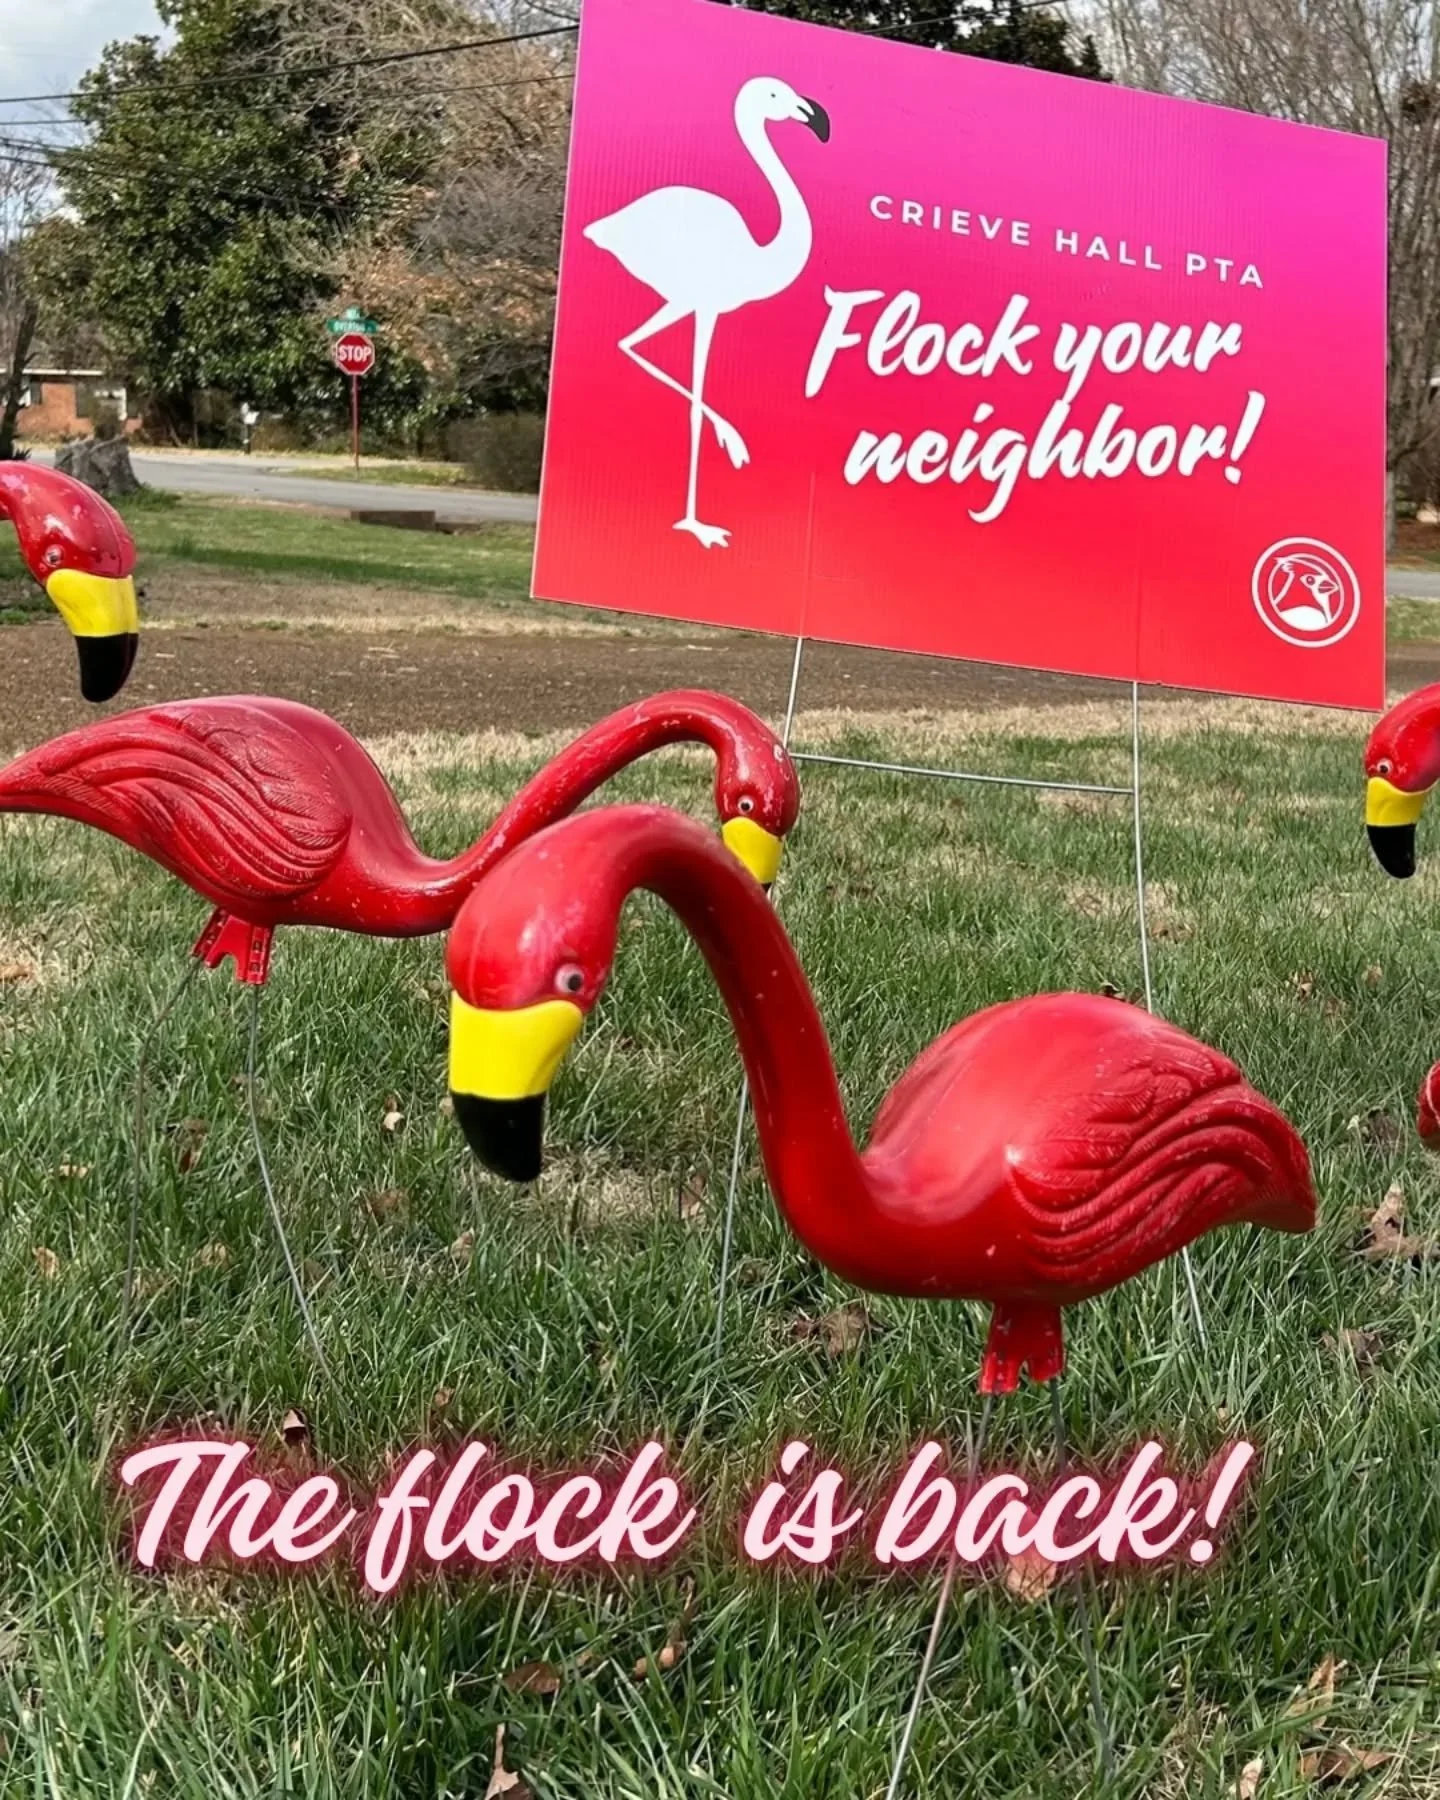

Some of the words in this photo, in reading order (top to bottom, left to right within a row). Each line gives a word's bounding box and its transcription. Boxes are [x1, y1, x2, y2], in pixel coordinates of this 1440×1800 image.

[869, 194, 1031, 247] CRIEVE
[1054, 228, 1163, 271] HALL
[1185, 252, 1264, 289] PTA
[339, 344, 372, 362] STOP
[804, 285, 1041, 398] Flock
[1053, 318, 1243, 402] your
[842, 390, 1267, 523] neighbor!
